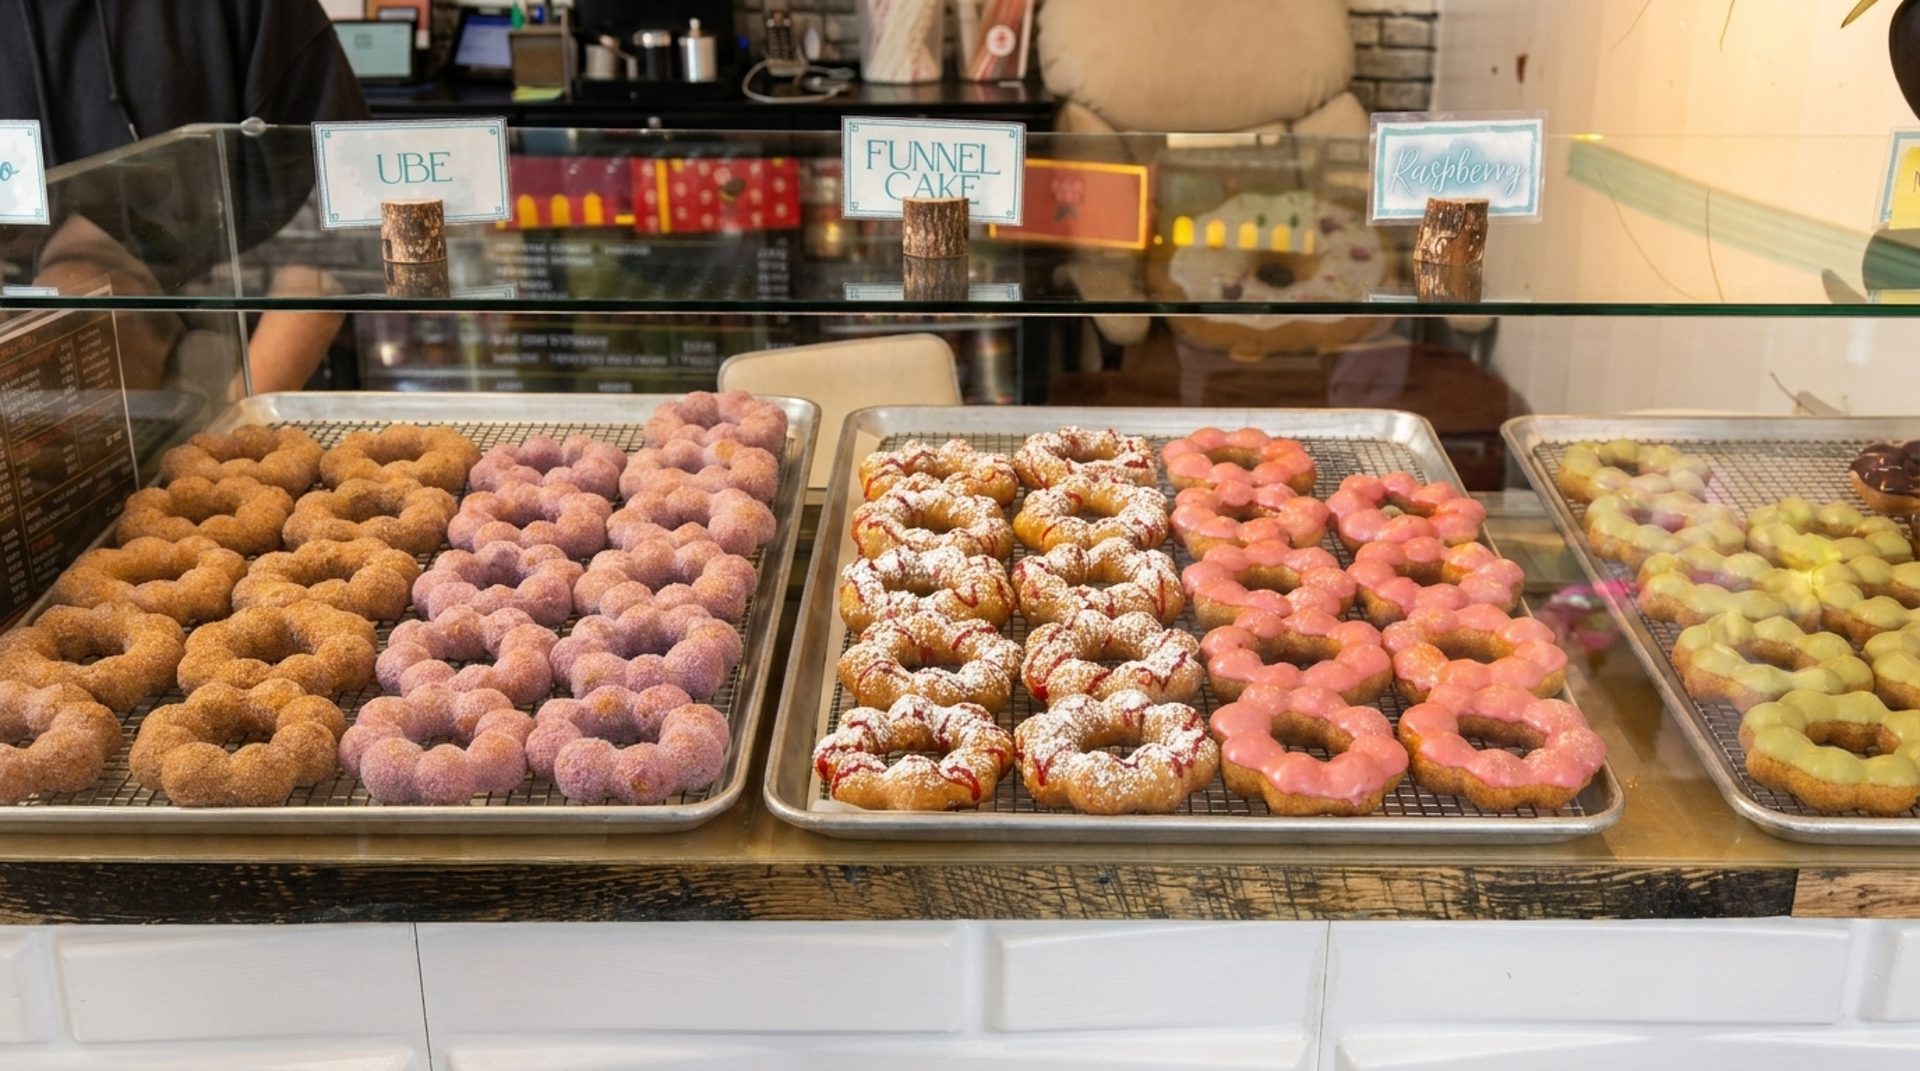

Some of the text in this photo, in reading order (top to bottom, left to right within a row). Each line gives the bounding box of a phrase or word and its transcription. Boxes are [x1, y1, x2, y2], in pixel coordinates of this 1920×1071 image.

[376, 151, 453, 184] UBE
[866, 139, 1001, 175] FUNNEL
[1389, 147, 1526, 197] Raspberry
[884, 171, 981, 205] CAKE
